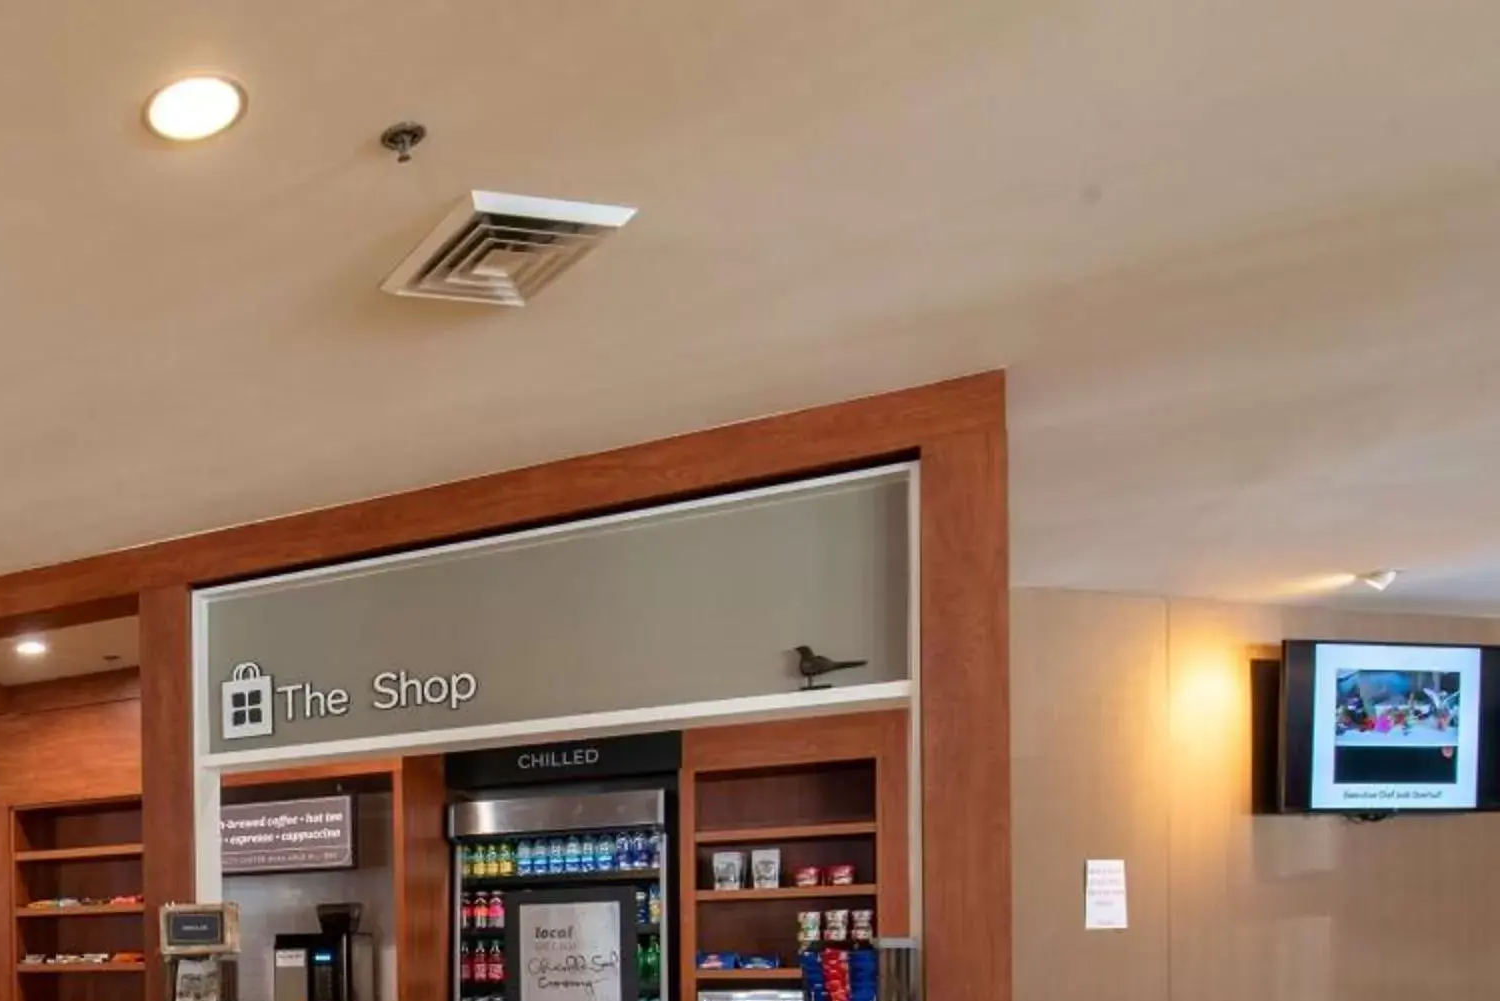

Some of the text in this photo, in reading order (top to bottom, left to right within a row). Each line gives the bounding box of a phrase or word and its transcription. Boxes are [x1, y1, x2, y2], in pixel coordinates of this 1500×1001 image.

[276, 669, 478, 722] The Shop
[517, 749, 599, 769] CHILLED
[267, 814, 298, 828] coffee
[229, 827, 341, 846] espresso cappuccino
[534, 926, 574, 940] local
